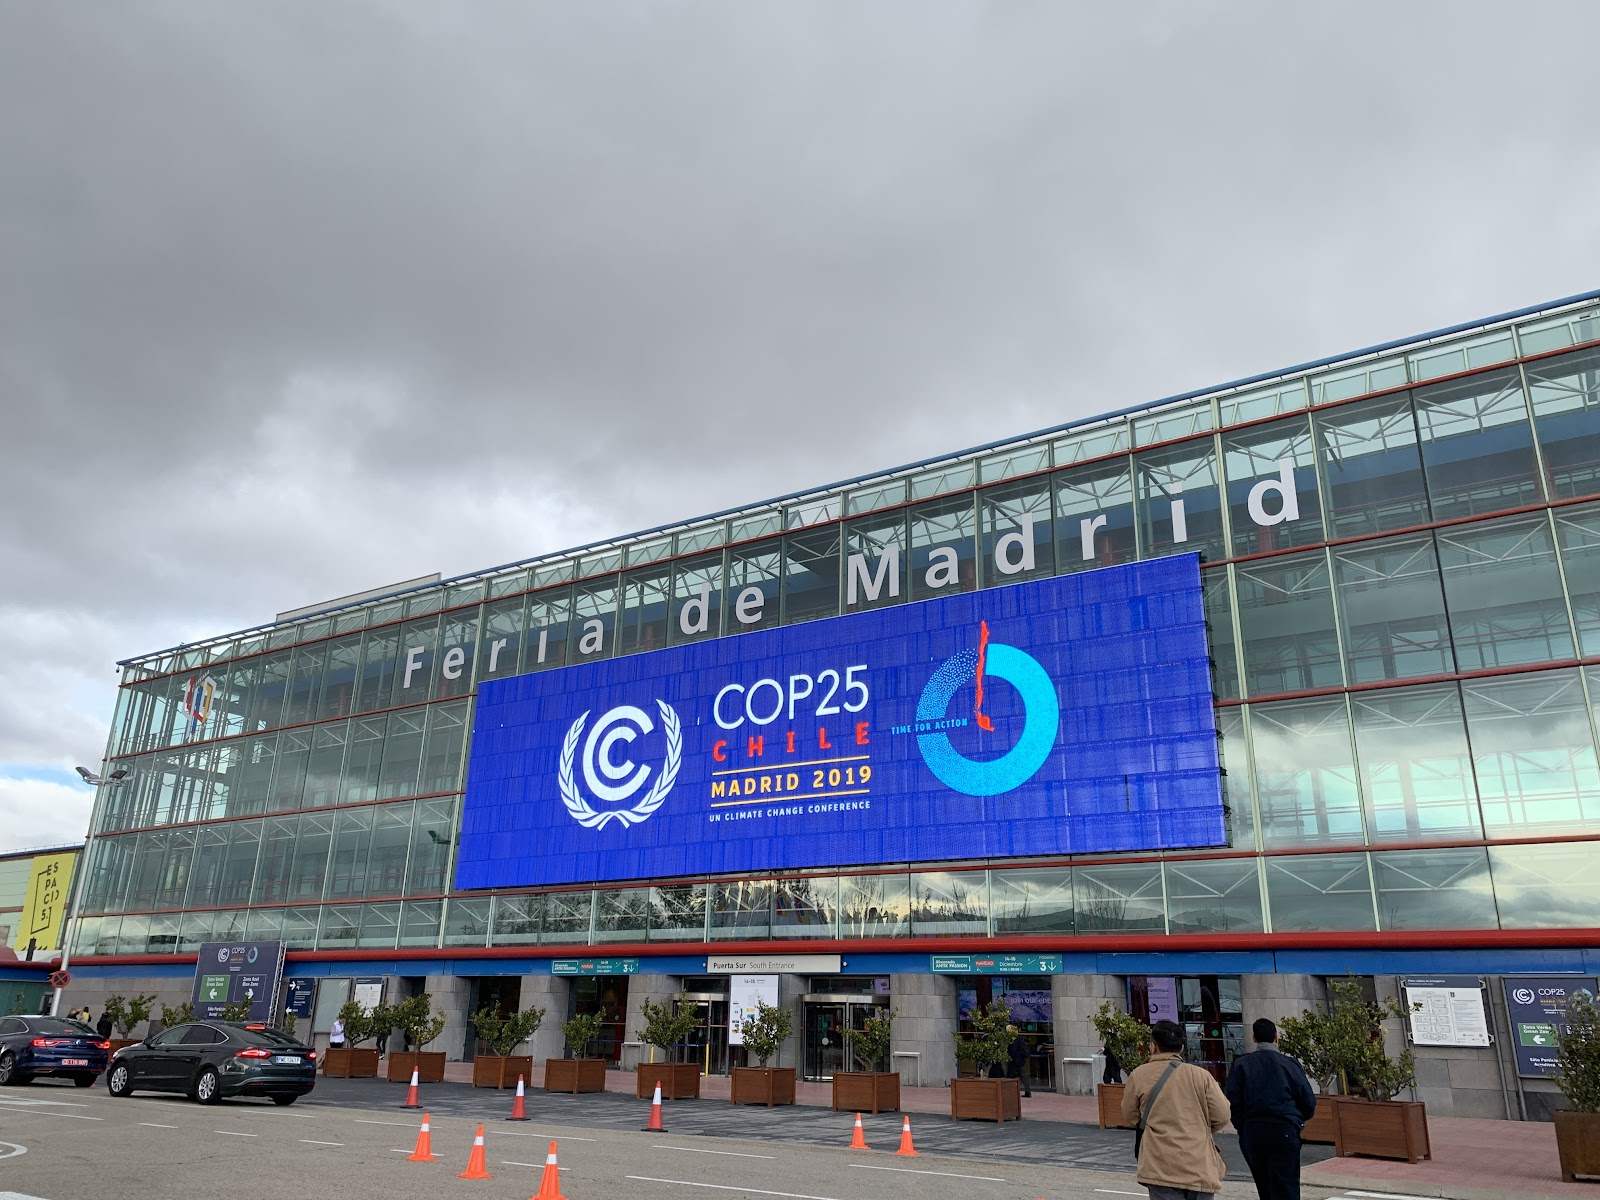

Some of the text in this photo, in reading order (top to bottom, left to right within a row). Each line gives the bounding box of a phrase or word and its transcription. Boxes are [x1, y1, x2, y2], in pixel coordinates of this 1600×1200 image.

[403, 458, 1300, 689] Feria de Madrid
[713, 664, 869, 730] COP25
[891, 718, 968, 735] TIME FOR ACTION
[713, 722, 869, 762] CHILE
[711, 765, 872, 798] MADRID 2019
[709, 801, 871, 822] UN CLIMATE CHANGE CONFERENCE
[623, 964, 628, 972] 3
[1040, 962, 1046, 971] 3
